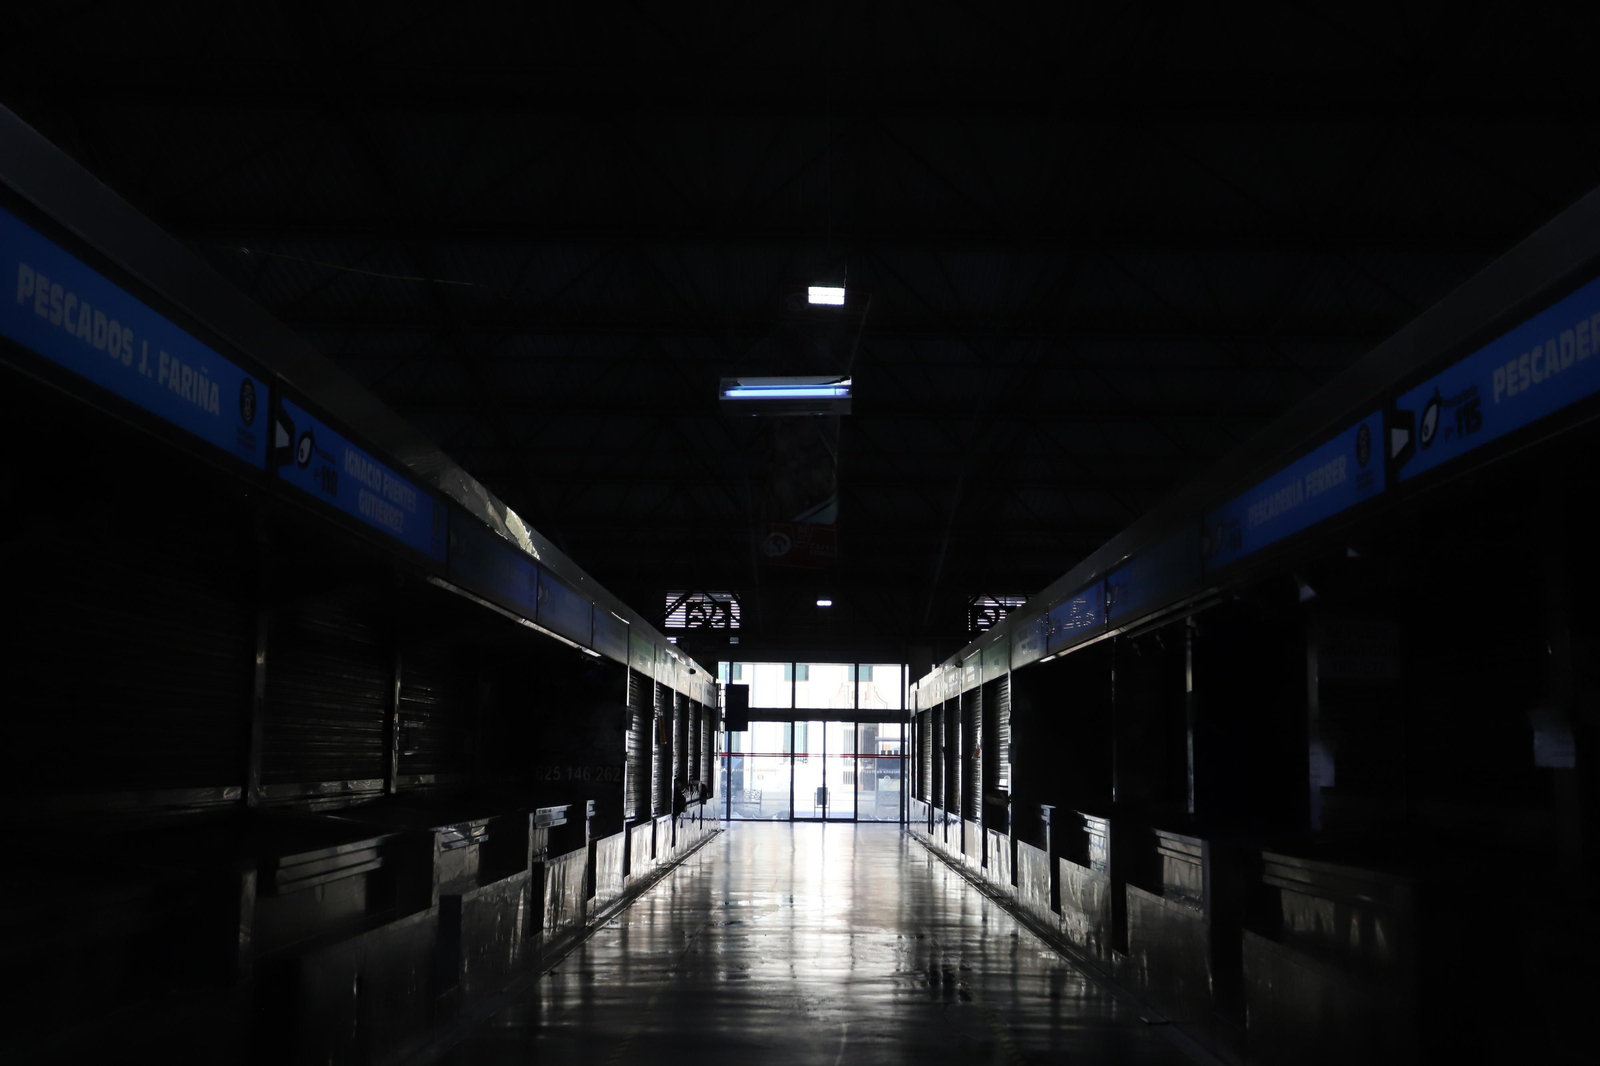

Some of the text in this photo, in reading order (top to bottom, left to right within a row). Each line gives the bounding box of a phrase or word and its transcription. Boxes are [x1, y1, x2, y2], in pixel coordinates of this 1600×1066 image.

[17, 262, 220, 417] PESCADOS J. FARIÑA
[345, 447, 382, 493] IGNACIO
[383, 473, 417, 513] FUENTES
[1305, 454, 1347, 500] FERRER
[566, 766, 591, 782] 146
[596, 766, 621, 783] 262
